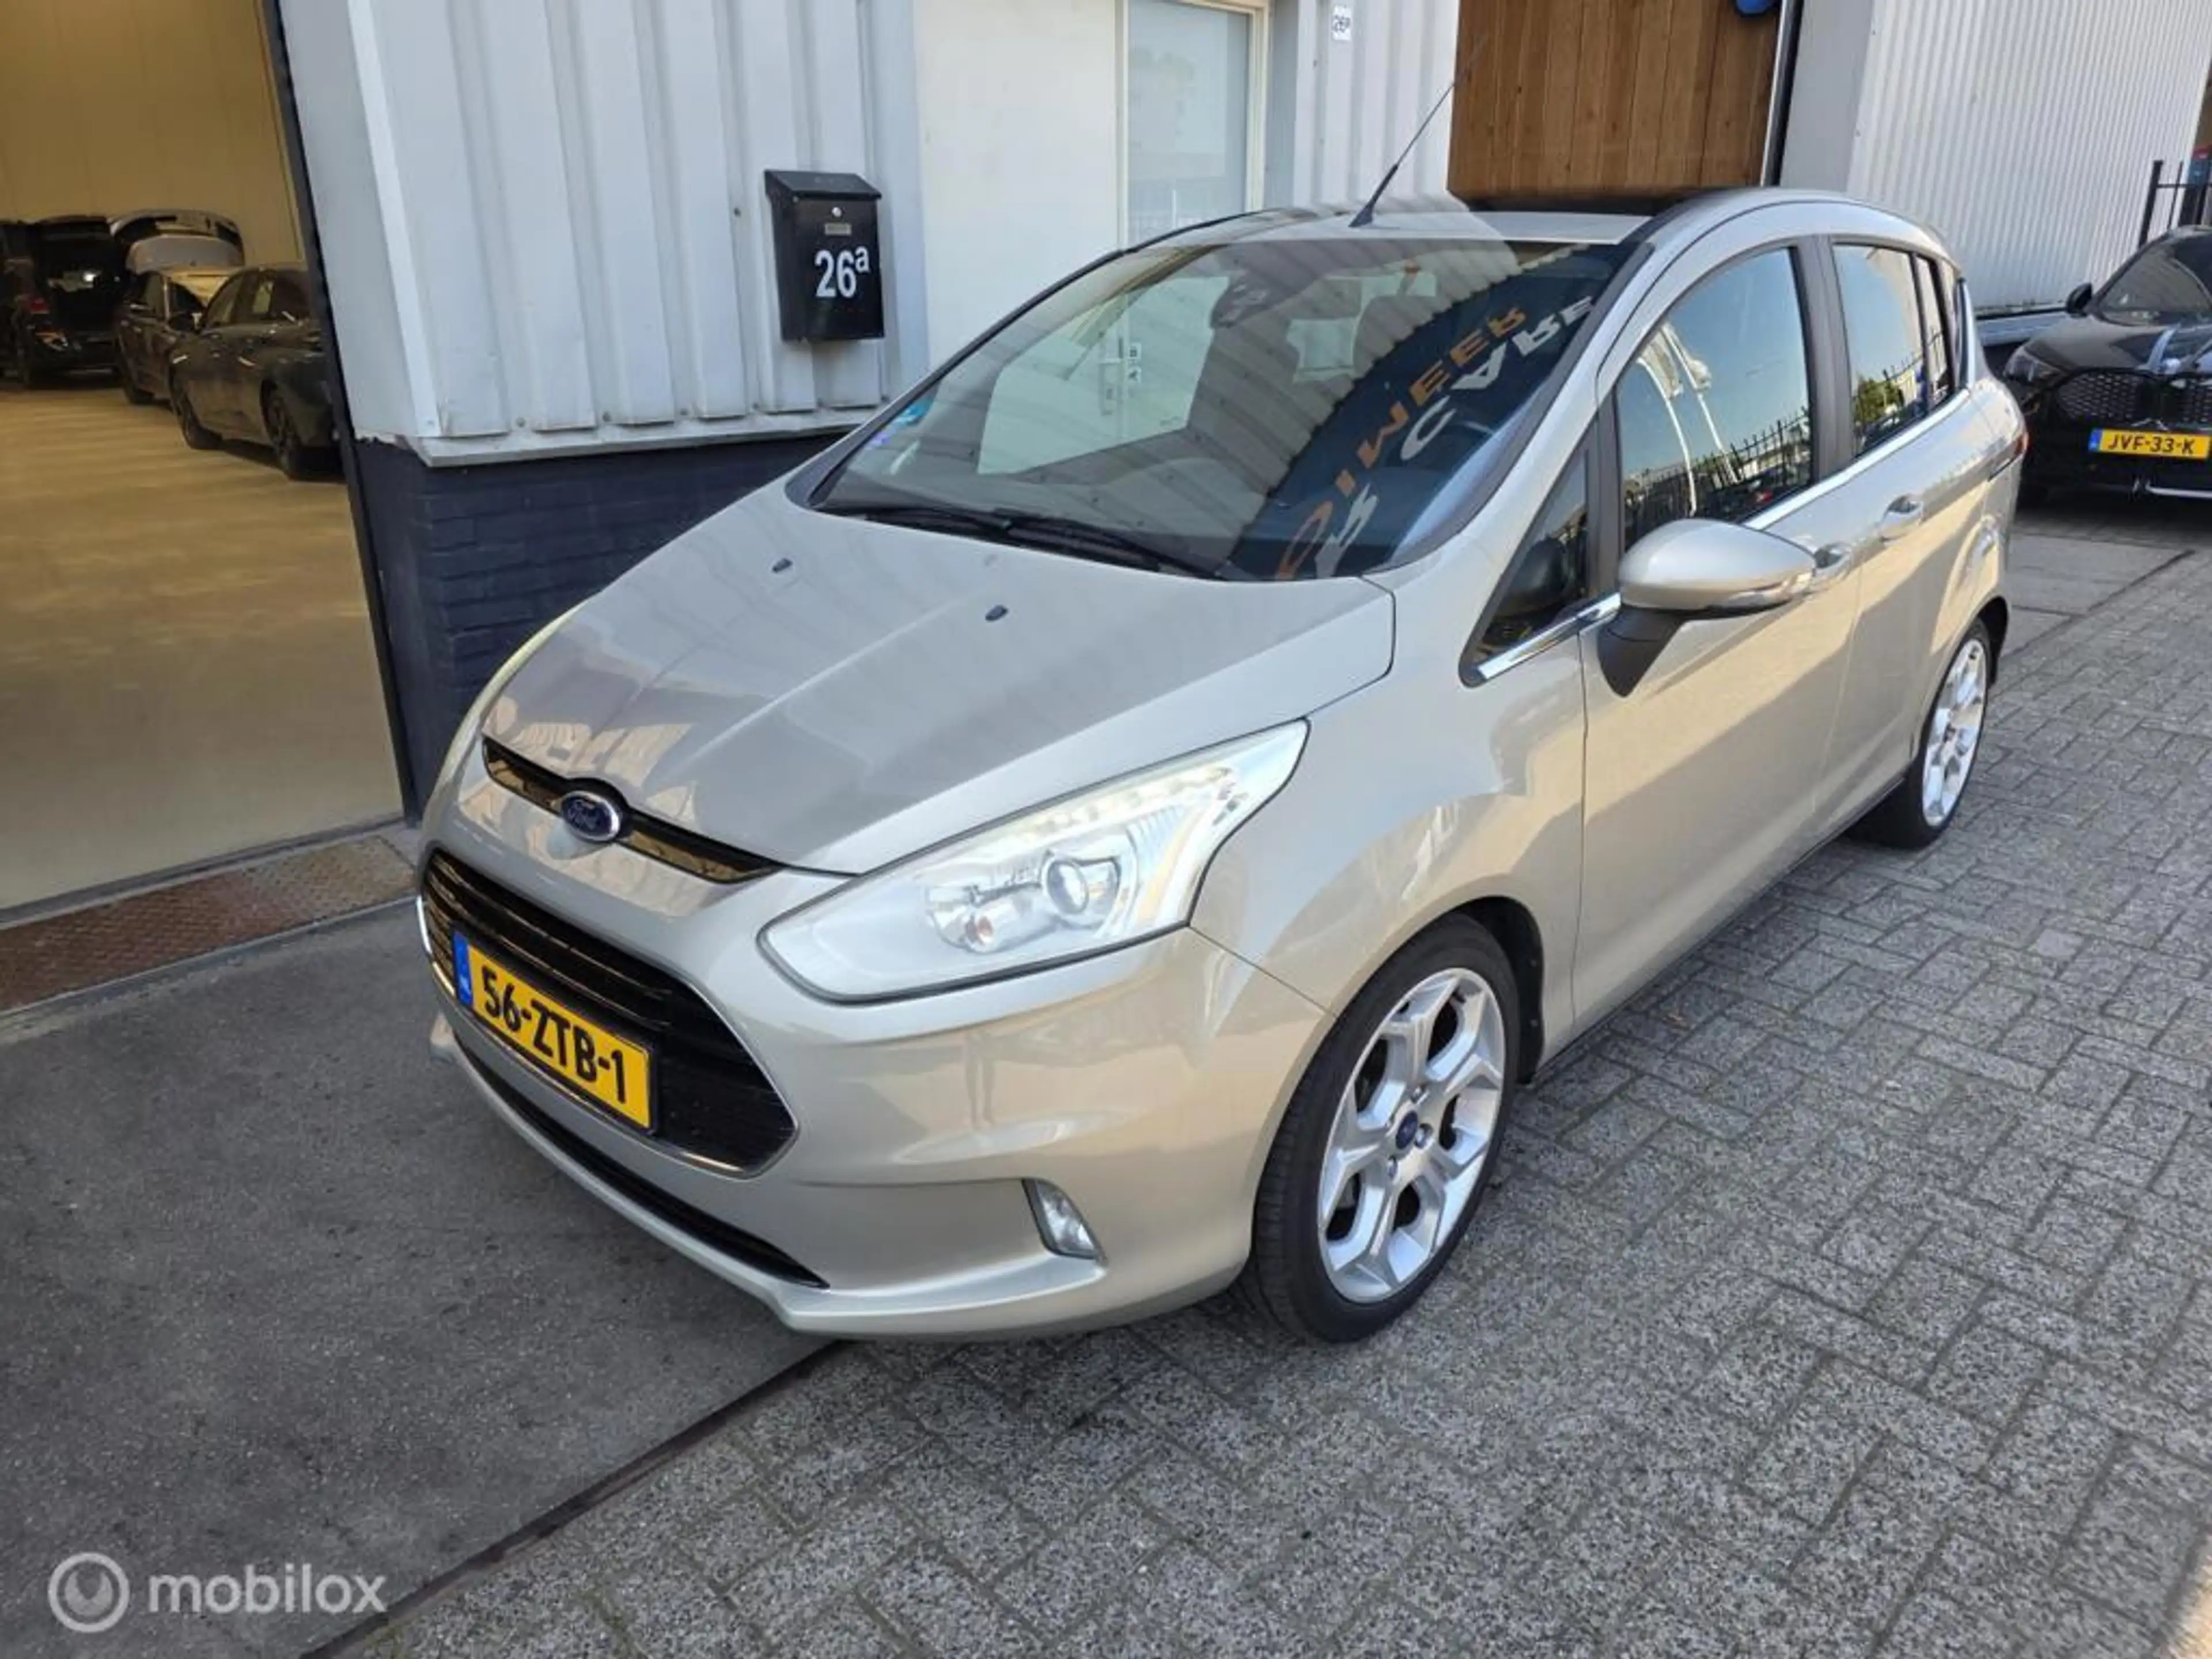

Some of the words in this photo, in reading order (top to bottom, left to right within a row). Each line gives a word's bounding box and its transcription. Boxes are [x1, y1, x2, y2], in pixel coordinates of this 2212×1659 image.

[815, 246, 870, 298] 26a
[2108, 434, 2195, 454] JVF-33-K
[482, 965, 626, 1104] 56-ZTB-1
